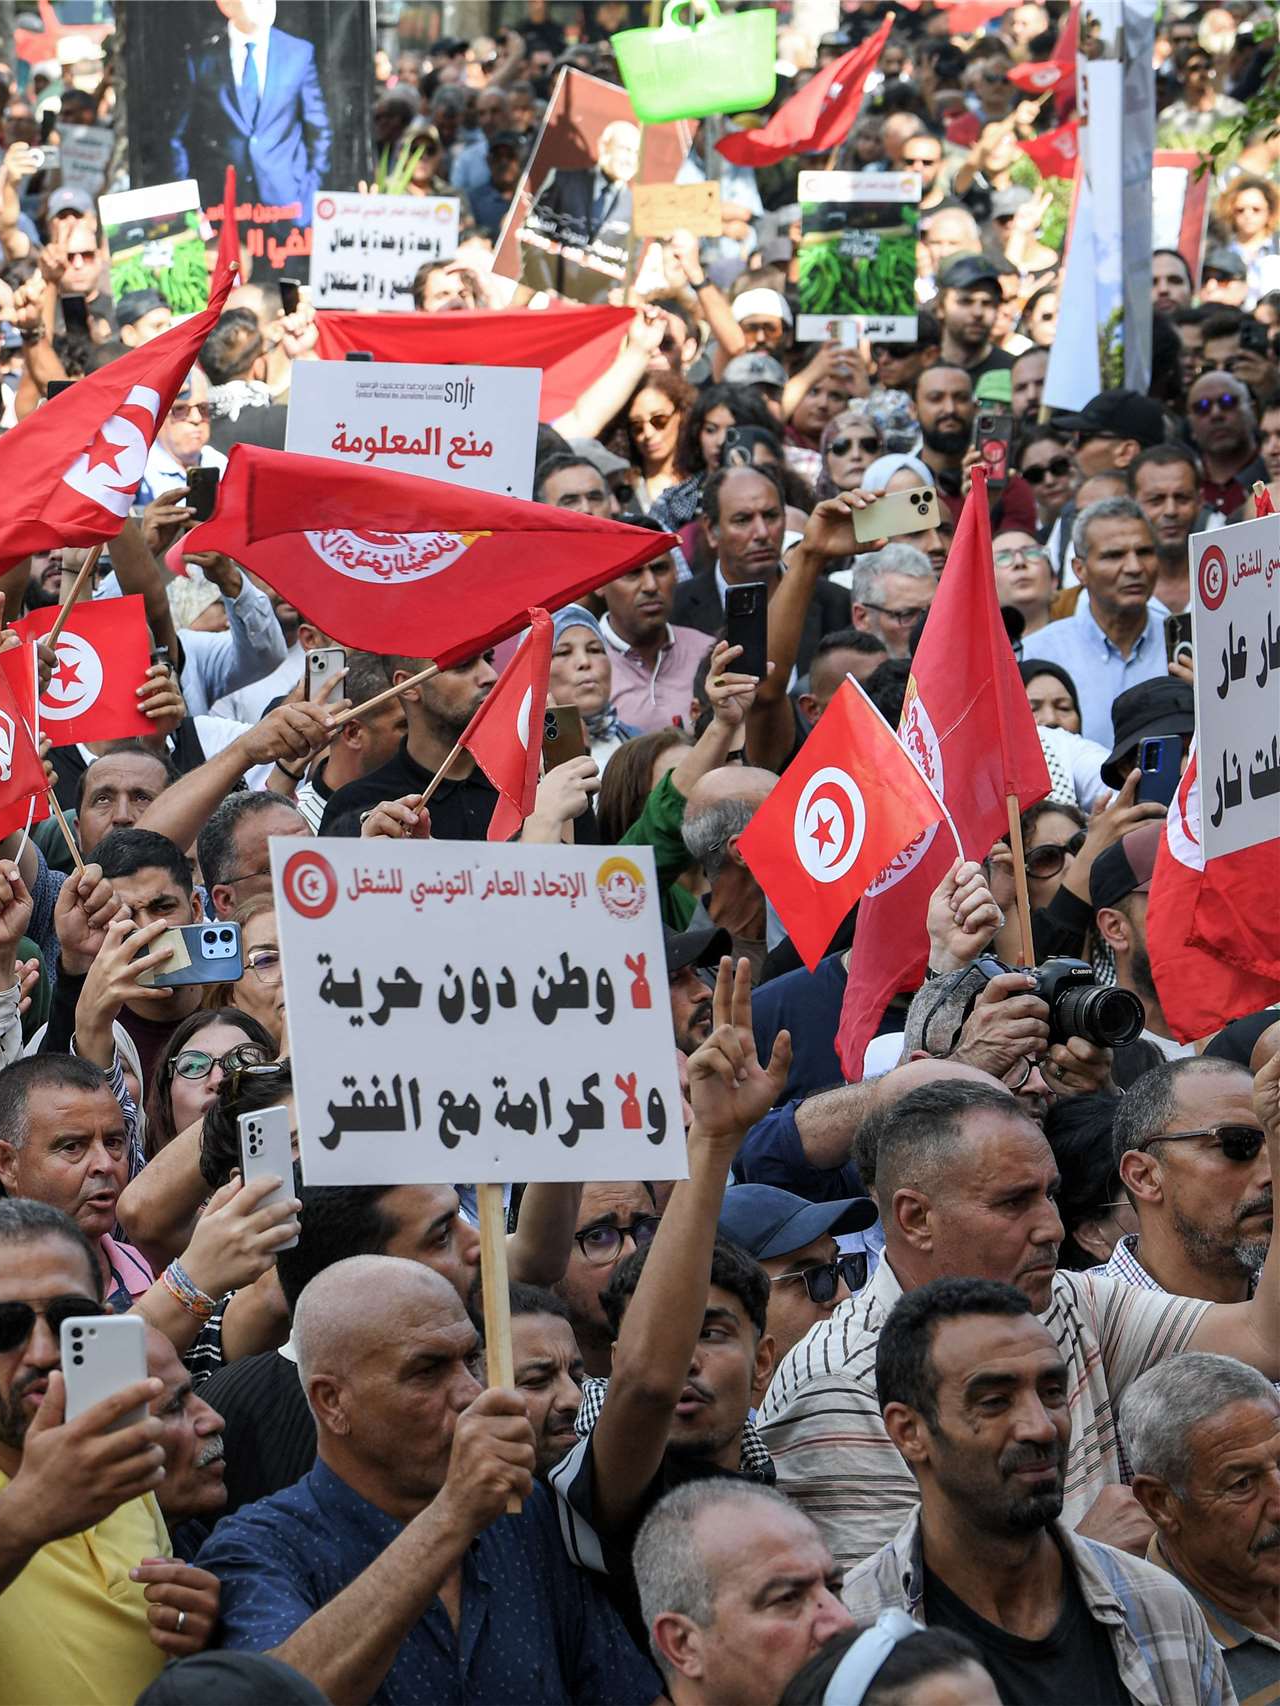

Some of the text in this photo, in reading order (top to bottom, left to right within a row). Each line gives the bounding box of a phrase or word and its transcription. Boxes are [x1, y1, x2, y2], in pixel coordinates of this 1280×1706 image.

[444, 376, 475, 410] snjt
[331, 422, 493, 469] منع المعلومة
[1232, 549, 1261, 587] للشغل
[1217, 621, 1247, 700] عار
[1211, 748, 1242, 828] نار
[347, 867, 402, 902] للشغل
[410, 869, 474, 912] التونسي
[481, 870, 527, 900] العام
[533, 871, 586, 909] الإتحاد
[317, 951, 652, 1028] لا وطن دون حرية
[318, 1073, 421, 1151] الفقر
[438, 1089, 481, 1149] مع
[493, 1071, 605, 1148] كرامة
